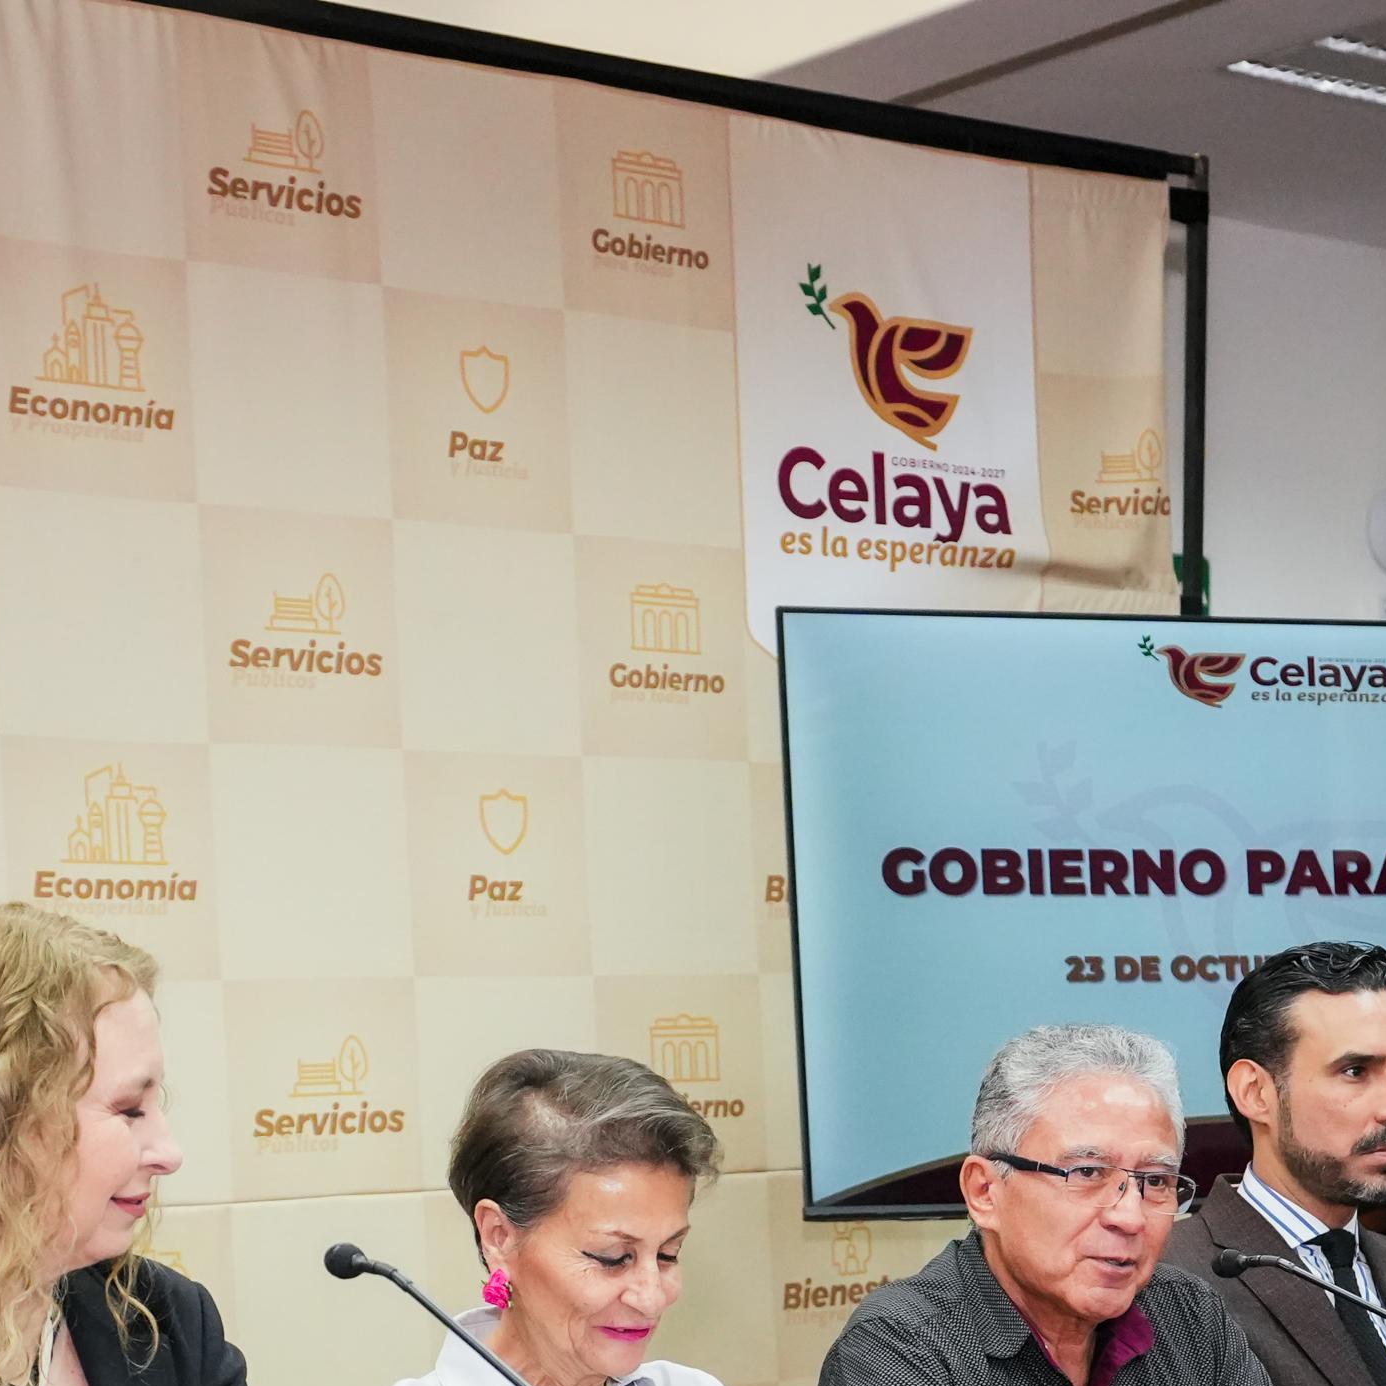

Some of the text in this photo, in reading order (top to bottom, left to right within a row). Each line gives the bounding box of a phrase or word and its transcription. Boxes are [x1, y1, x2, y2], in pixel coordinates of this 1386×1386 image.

[208, 167, 362, 219] Servicios
[592, 228, 710, 269] Gobierno
[8, 386, 175, 430] Economía
[448, 430, 504, 462] Paz
[891, 456, 1006, 478] GOBIERNO 2024-2027
[778, 446, 1013, 542] Celaya
[780, 526, 1016, 572] es la esperanza
[229, 639, 382, 677] Servicios
[609, 663, 725, 694] Gobierno
[1251, 690, 1269, 702] es
[1275, 688, 1292, 702] la
[34, 870, 197, 902] Economía
[468, 875, 523, 902] Paz
[881, 847, 1226, 898] GOBIERNO
[1065, 955, 1265, 982] 23 DE OCTU
[254, 1101, 405, 1138] Servicios
